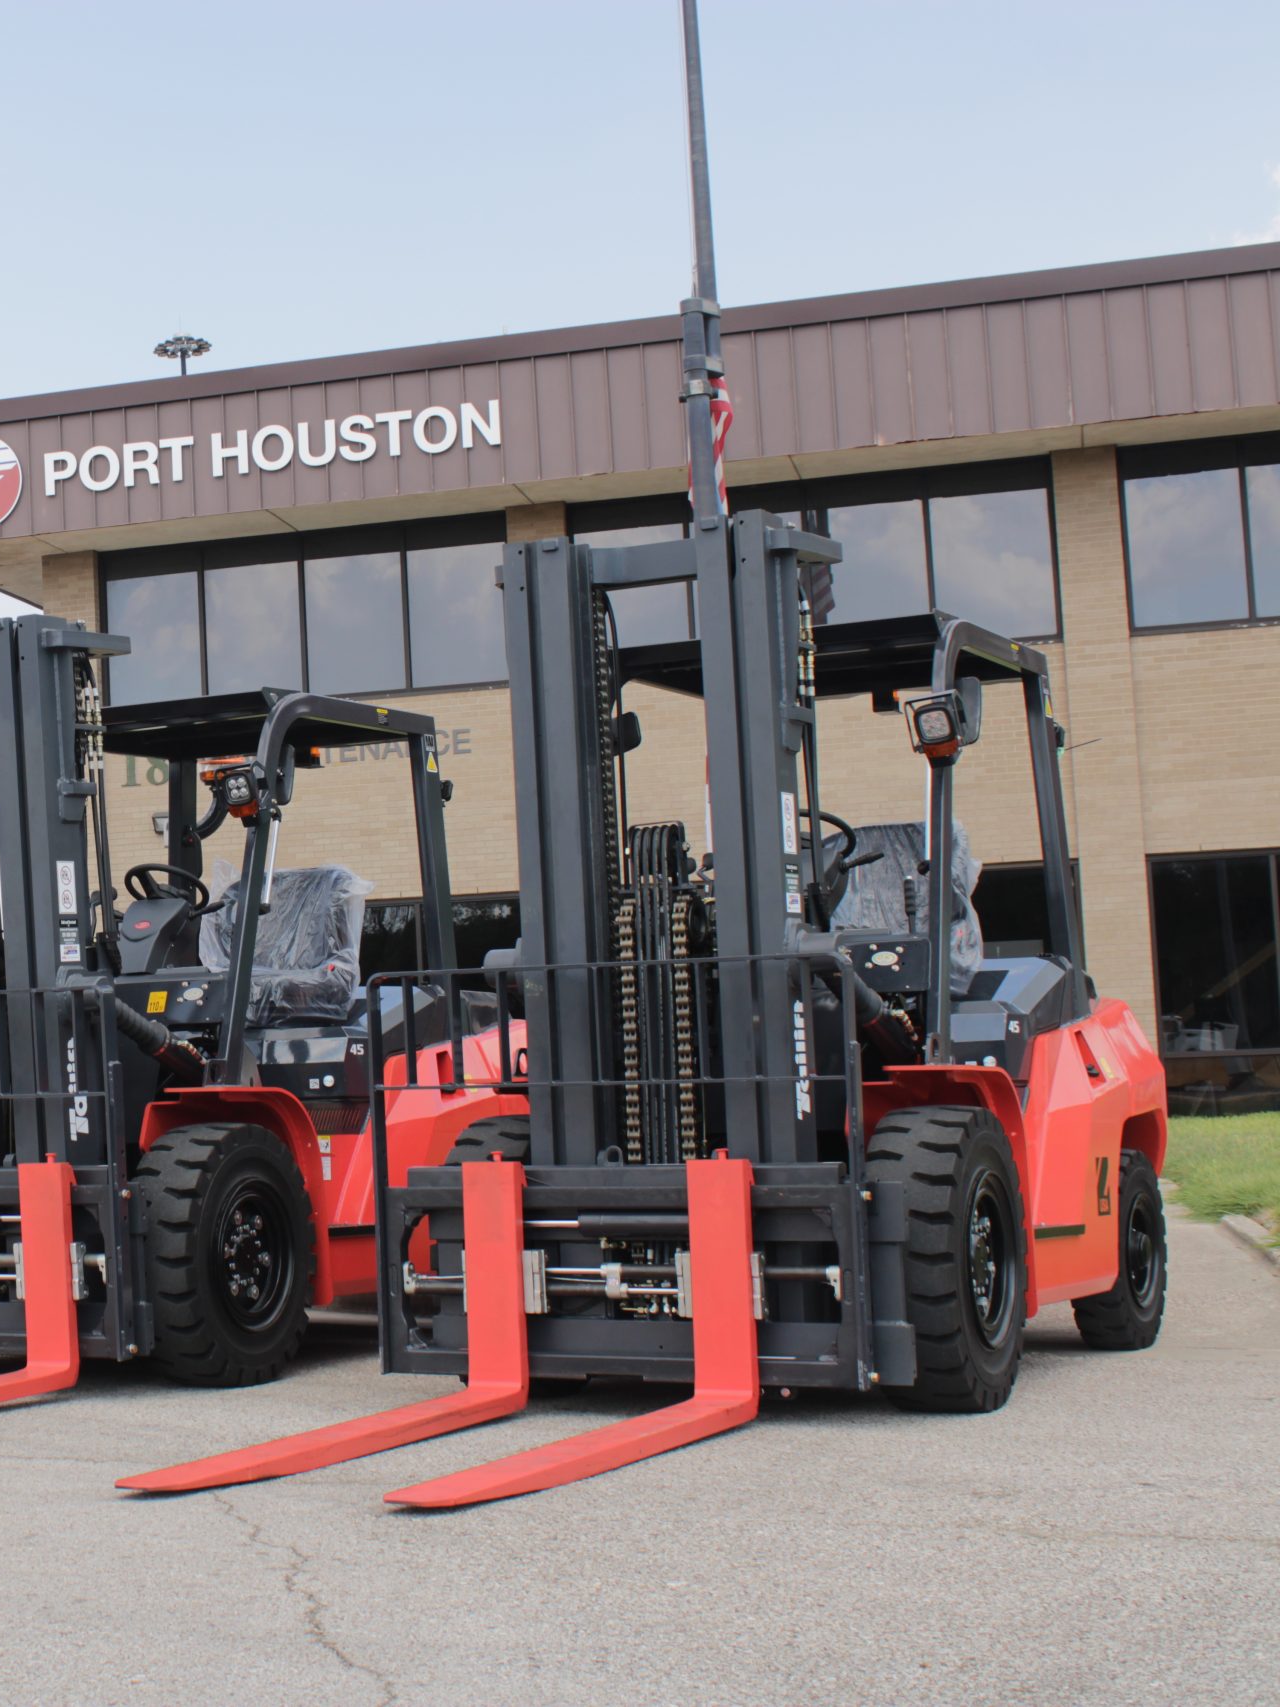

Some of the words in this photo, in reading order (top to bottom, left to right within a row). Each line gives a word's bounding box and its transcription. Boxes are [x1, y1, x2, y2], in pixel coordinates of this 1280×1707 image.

[44, 436, 194, 497] PORT
[211, 399, 501, 477] HOUSTON
[1008, 1020, 1021, 1033] 45
[349, 1043, 365, 1056] 45
